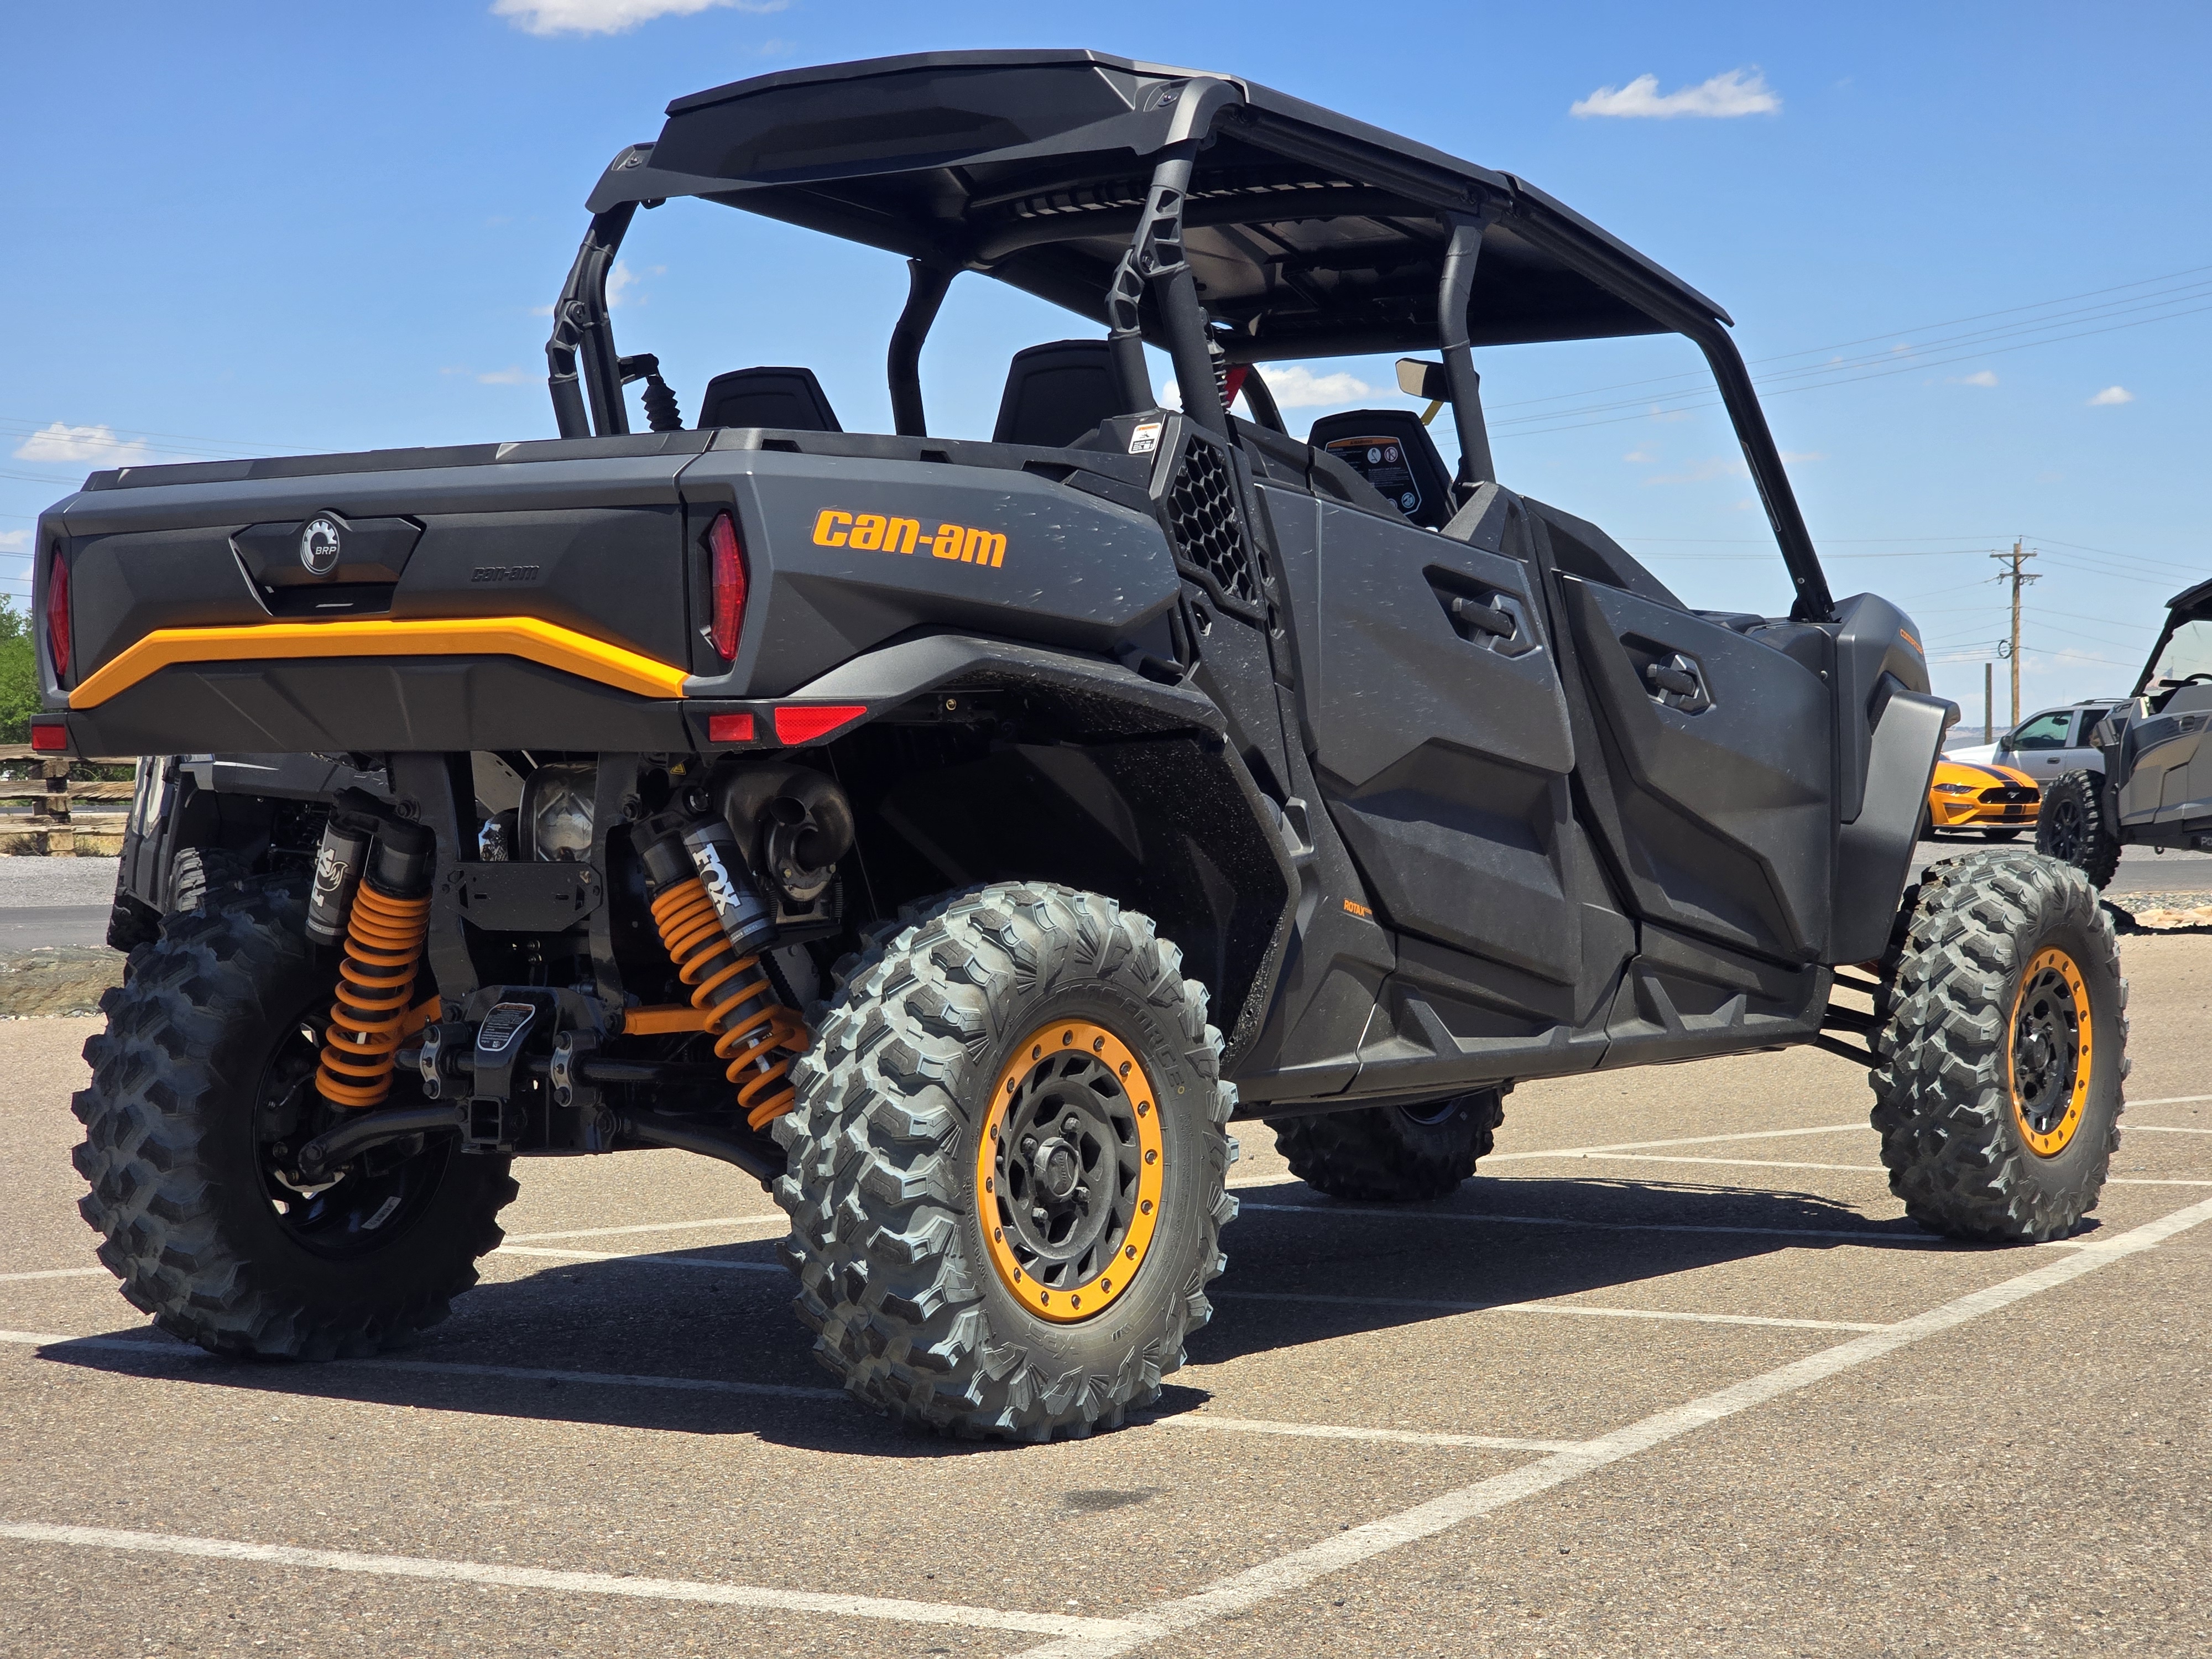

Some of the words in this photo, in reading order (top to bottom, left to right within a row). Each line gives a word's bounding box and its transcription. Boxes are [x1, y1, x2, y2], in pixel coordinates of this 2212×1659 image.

[315, 546, 337, 555] BRP
[812, 509, 1008, 568] can-am
[471, 565, 540, 582] can-am
[692, 842, 741, 917] FOX
[1343, 899, 1365, 917] ROTAX
[1120, 997, 1185, 1088] FORCE
[1024, 1321, 1080, 1360] XPS
